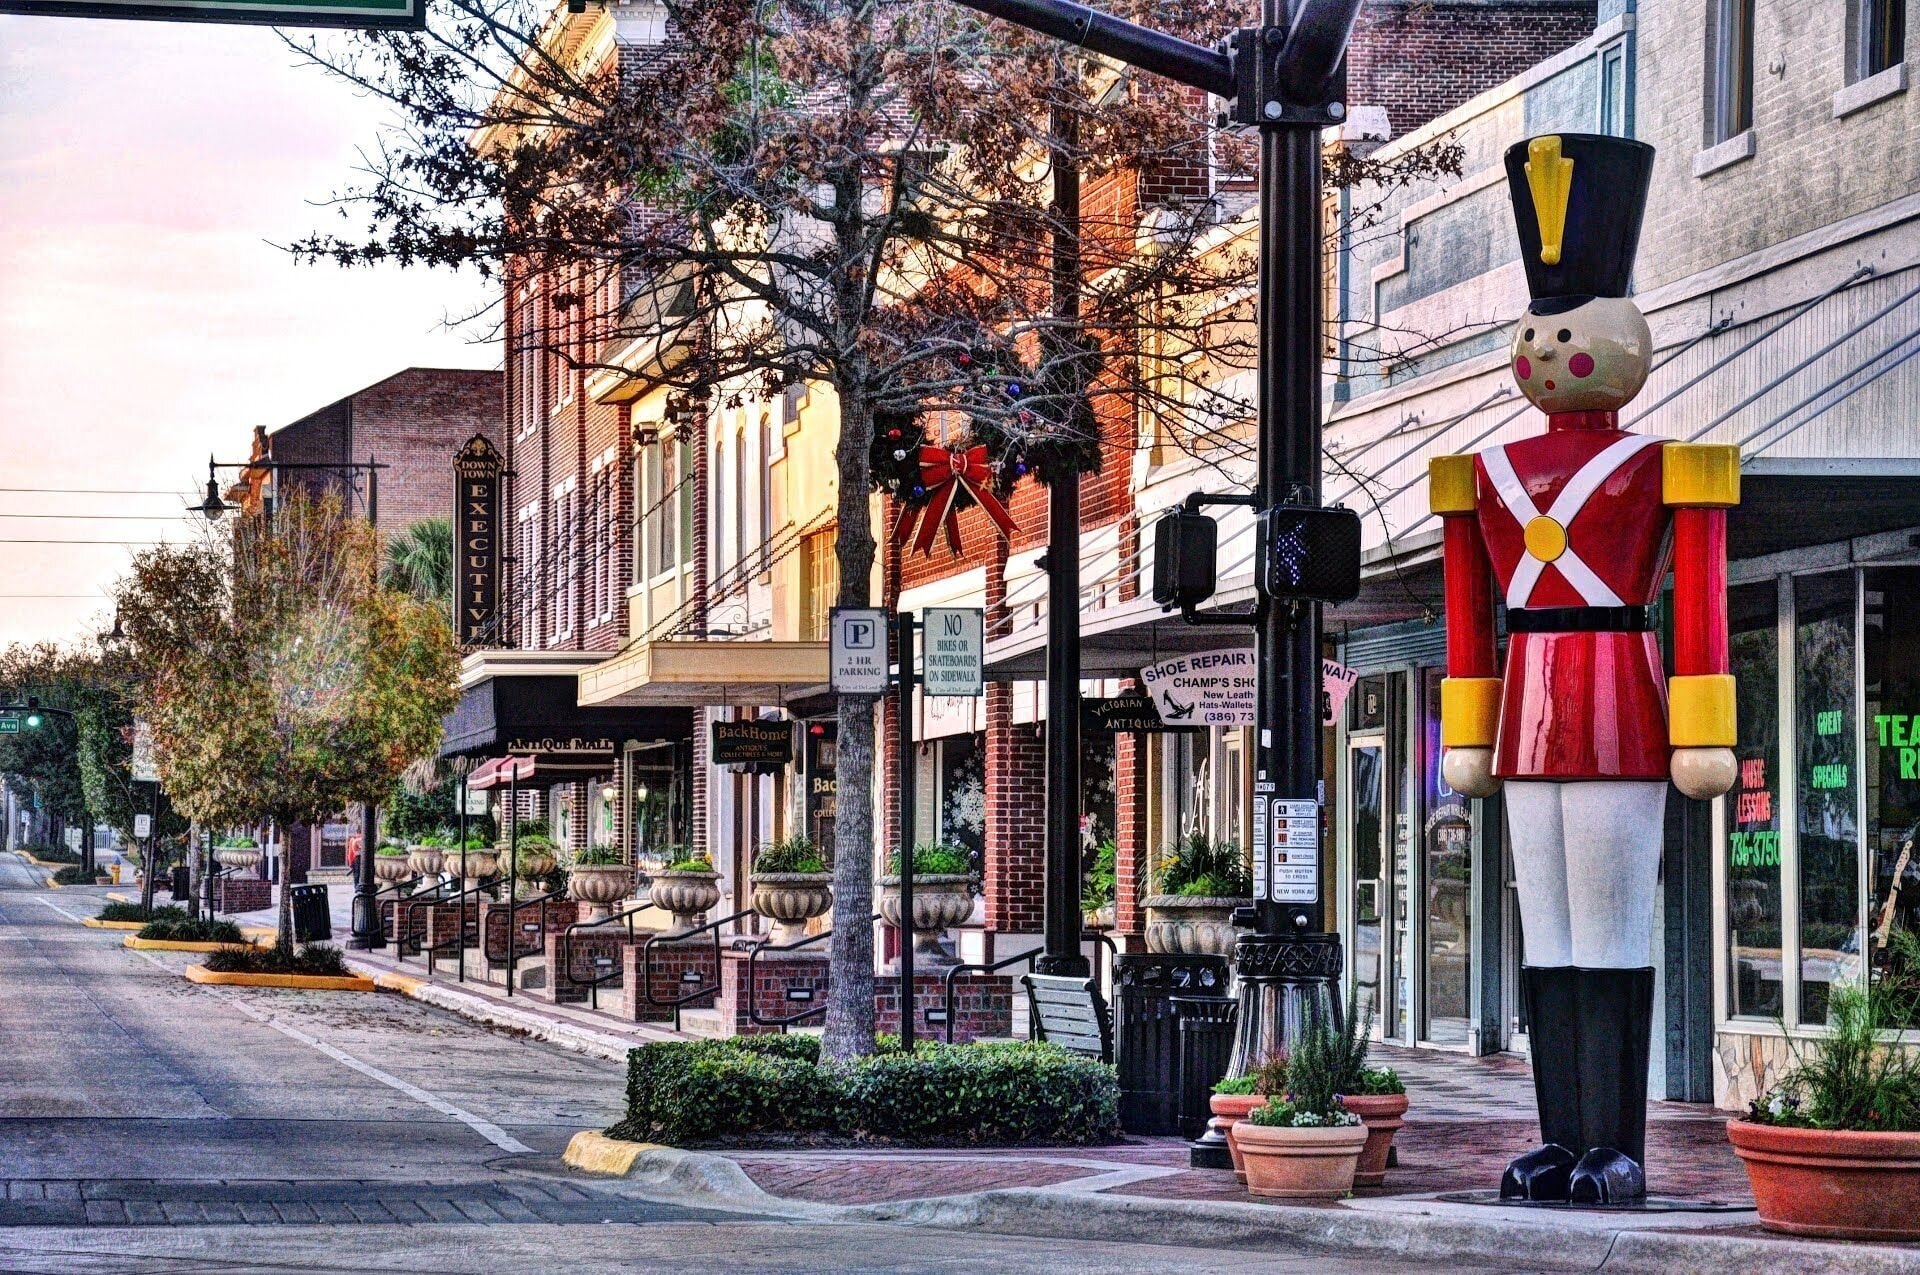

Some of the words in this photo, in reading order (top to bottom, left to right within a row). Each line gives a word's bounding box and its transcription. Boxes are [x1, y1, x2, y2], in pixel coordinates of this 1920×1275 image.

[462, 461, 496, 470] DOWN
[462, 470, 495, 479] TOWN
[468, 484, 489, 638] EXECUTIVE
[944, 614, 962, 636] NO
[850, 624, 869, 644] P
[937, 640, 957, 652] BIKES
[958, 640, 968, 652] OR
[848, 656, 853, 665] 2
[856, 656, 872, 665] HR
[928, 654, 977, 667] SKATEBOARDS
[839, 667, 881, 676] PARKING
[1145, 660, 1187, 683] SHOE
[1191, 653, 1247, 671] REPAIR
[929, 670, 939, 682] ON
[941, 670, 976, 682] SIDEWALK
[1173, 677, 1230, 688] CHAMP'S
[1203, 690, 1224, 699] New
[1091, 699, 1143, 717] VICTORIAN
[1204, 712, 1236, 723] (386)
[1817, 710, 1843, 736] GREAT
[1, 721, 16, 729] Ave
[509, 740, 571, 752] ANTIQUE
[574, 740, 613, 750] MALL
[1900, 748, 1920, 780] R
[1742, 758, 1765, 789] MUSIC
[1812, 764, 1848, 789] SPECIALS
[1737, 791, 1772, 823] LESSONS
